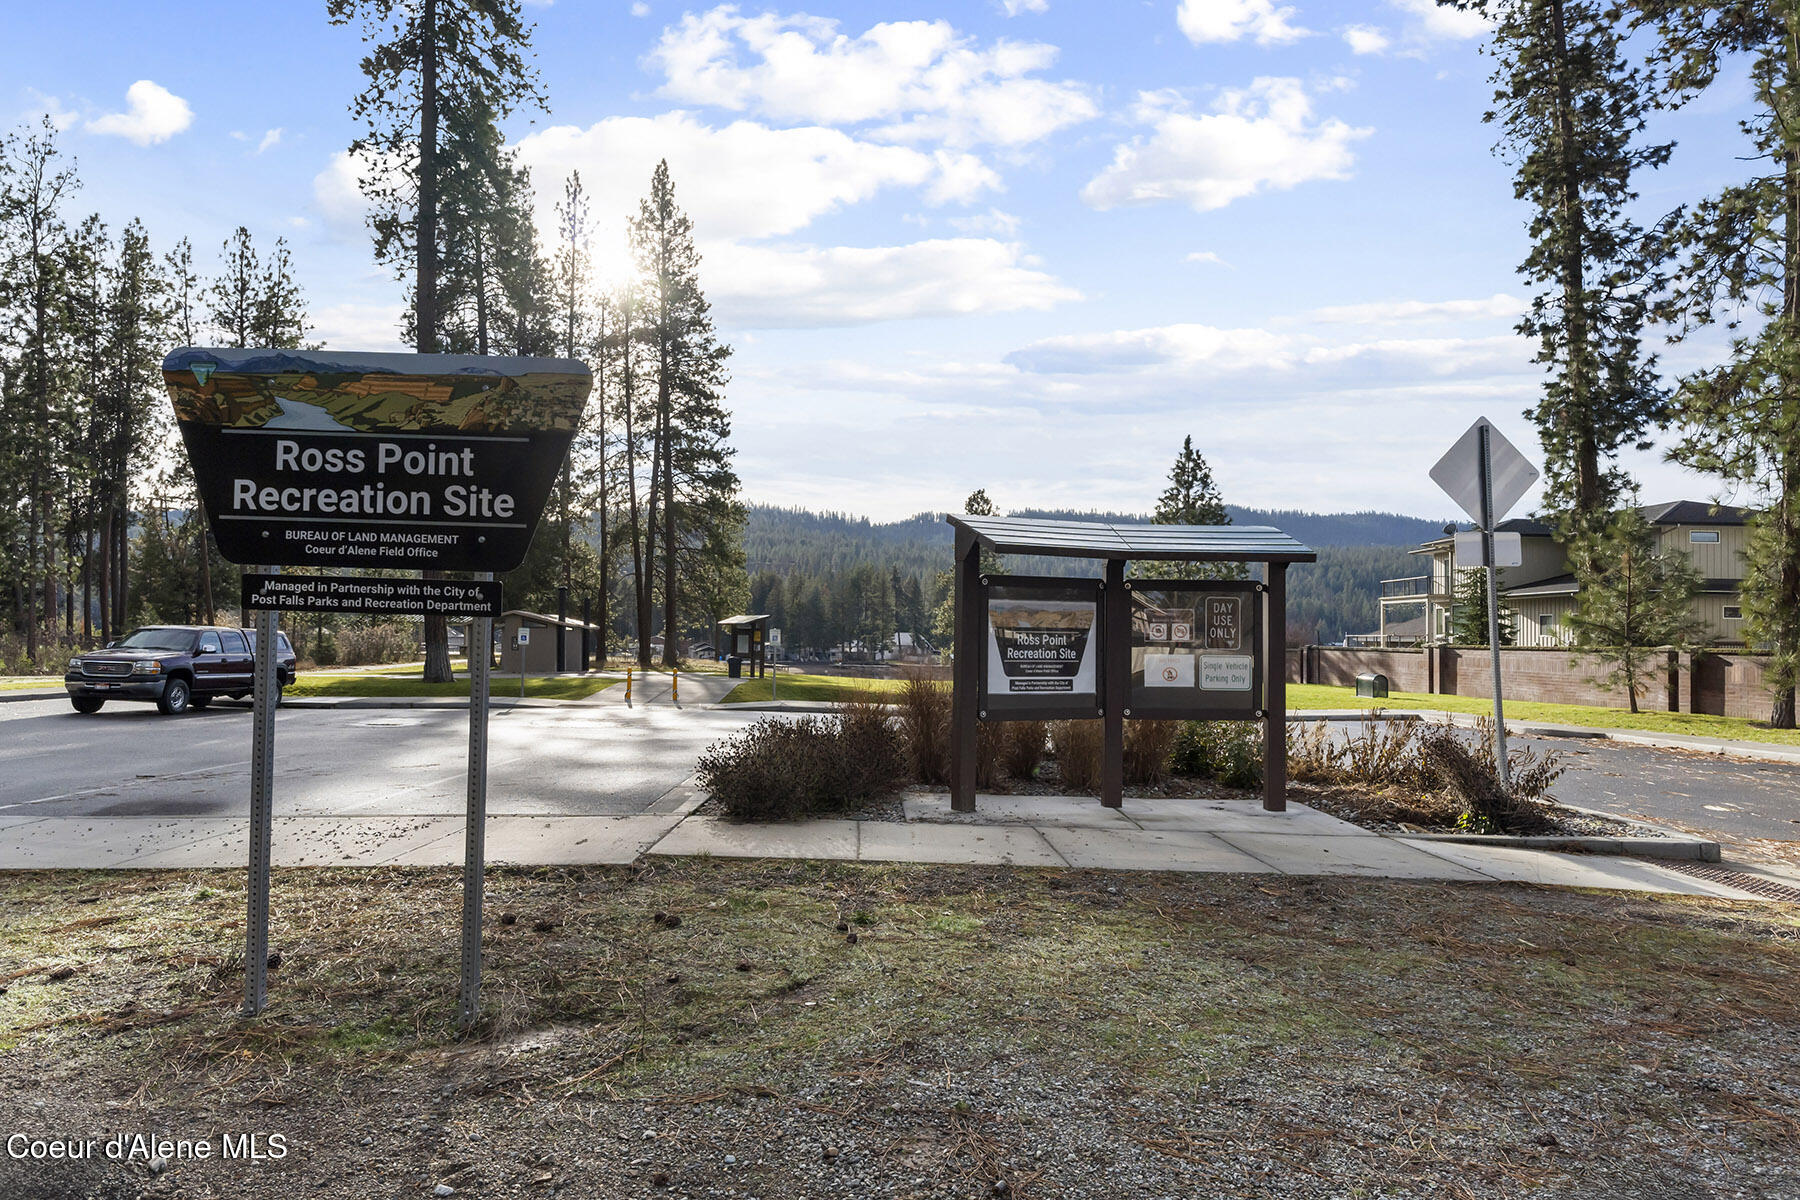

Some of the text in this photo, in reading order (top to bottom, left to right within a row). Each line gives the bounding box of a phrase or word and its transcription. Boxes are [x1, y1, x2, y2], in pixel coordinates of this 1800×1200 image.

[275, 439, 475, 477] Ross Point
[232, 478, 516, 518] Recreation Site
[285, 530, 460, 544] BUREAU OF LAND MANAGEMENT
[305, 544, 439, 558] Coeur d'Alene Field Office
[264, 580, 481, 599] Managed in Partnership with the City of
[251, 594, 492, 612] Post Falls Parks and Recreation Department
[1213, 602, 1234, 613] DAY
[1213, 615, 1233, 626] USE
[1209, 628, 1237, 639] ONLY
[1017, 634, 1067, 646] Ross Point
[1007, 647, 1077, 659] Recreation Site
[1203, 661, 1223, 671] Single
[1205, 674, 1229, 684] Parking
